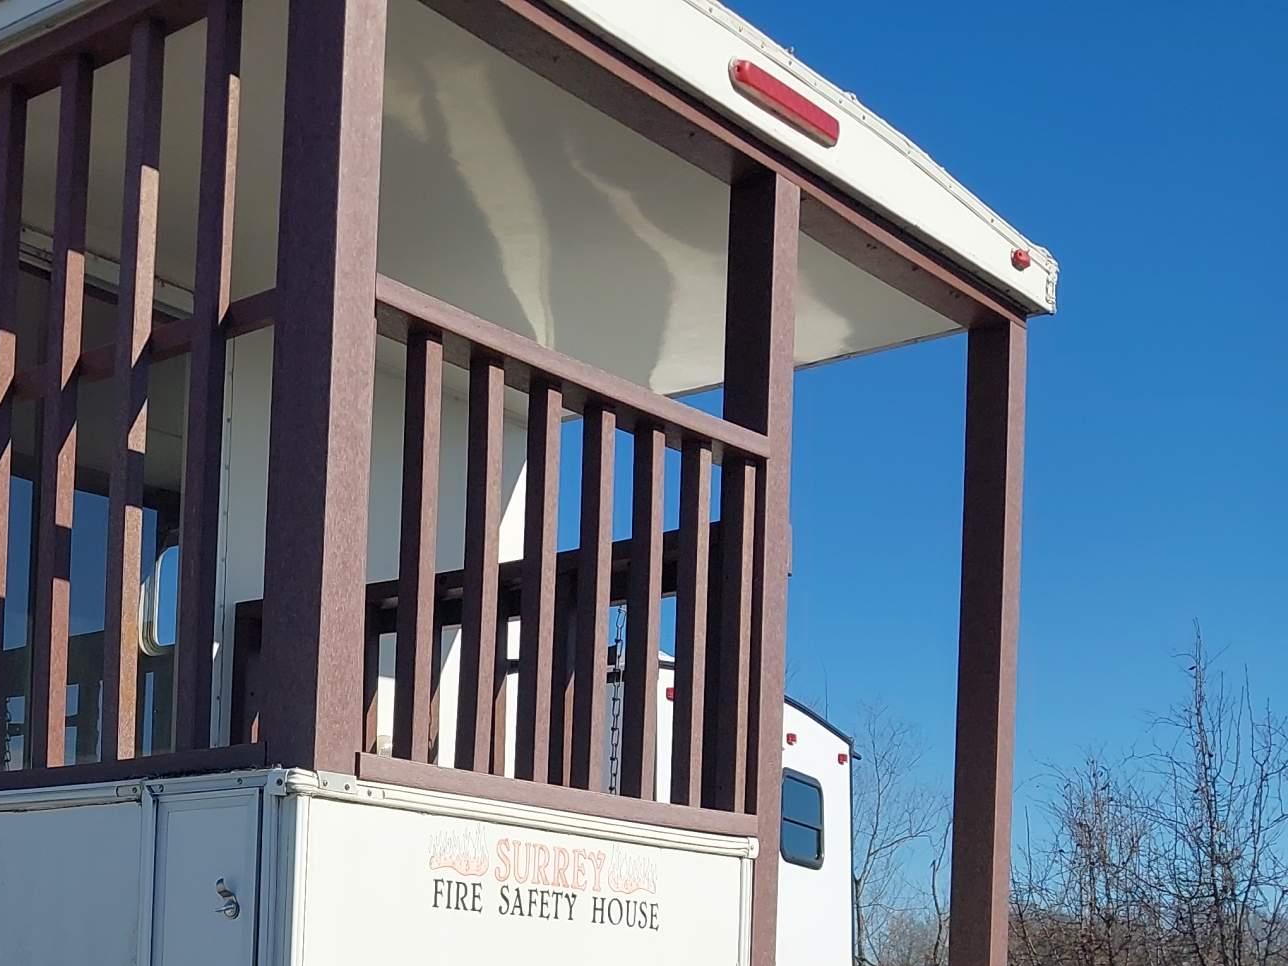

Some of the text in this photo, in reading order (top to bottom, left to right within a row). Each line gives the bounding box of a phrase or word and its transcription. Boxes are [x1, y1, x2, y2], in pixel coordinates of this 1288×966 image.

[494, 837, 607, 891] SURREY
[431, 878, 660, 931] FIRE SAFETY HOUSE
